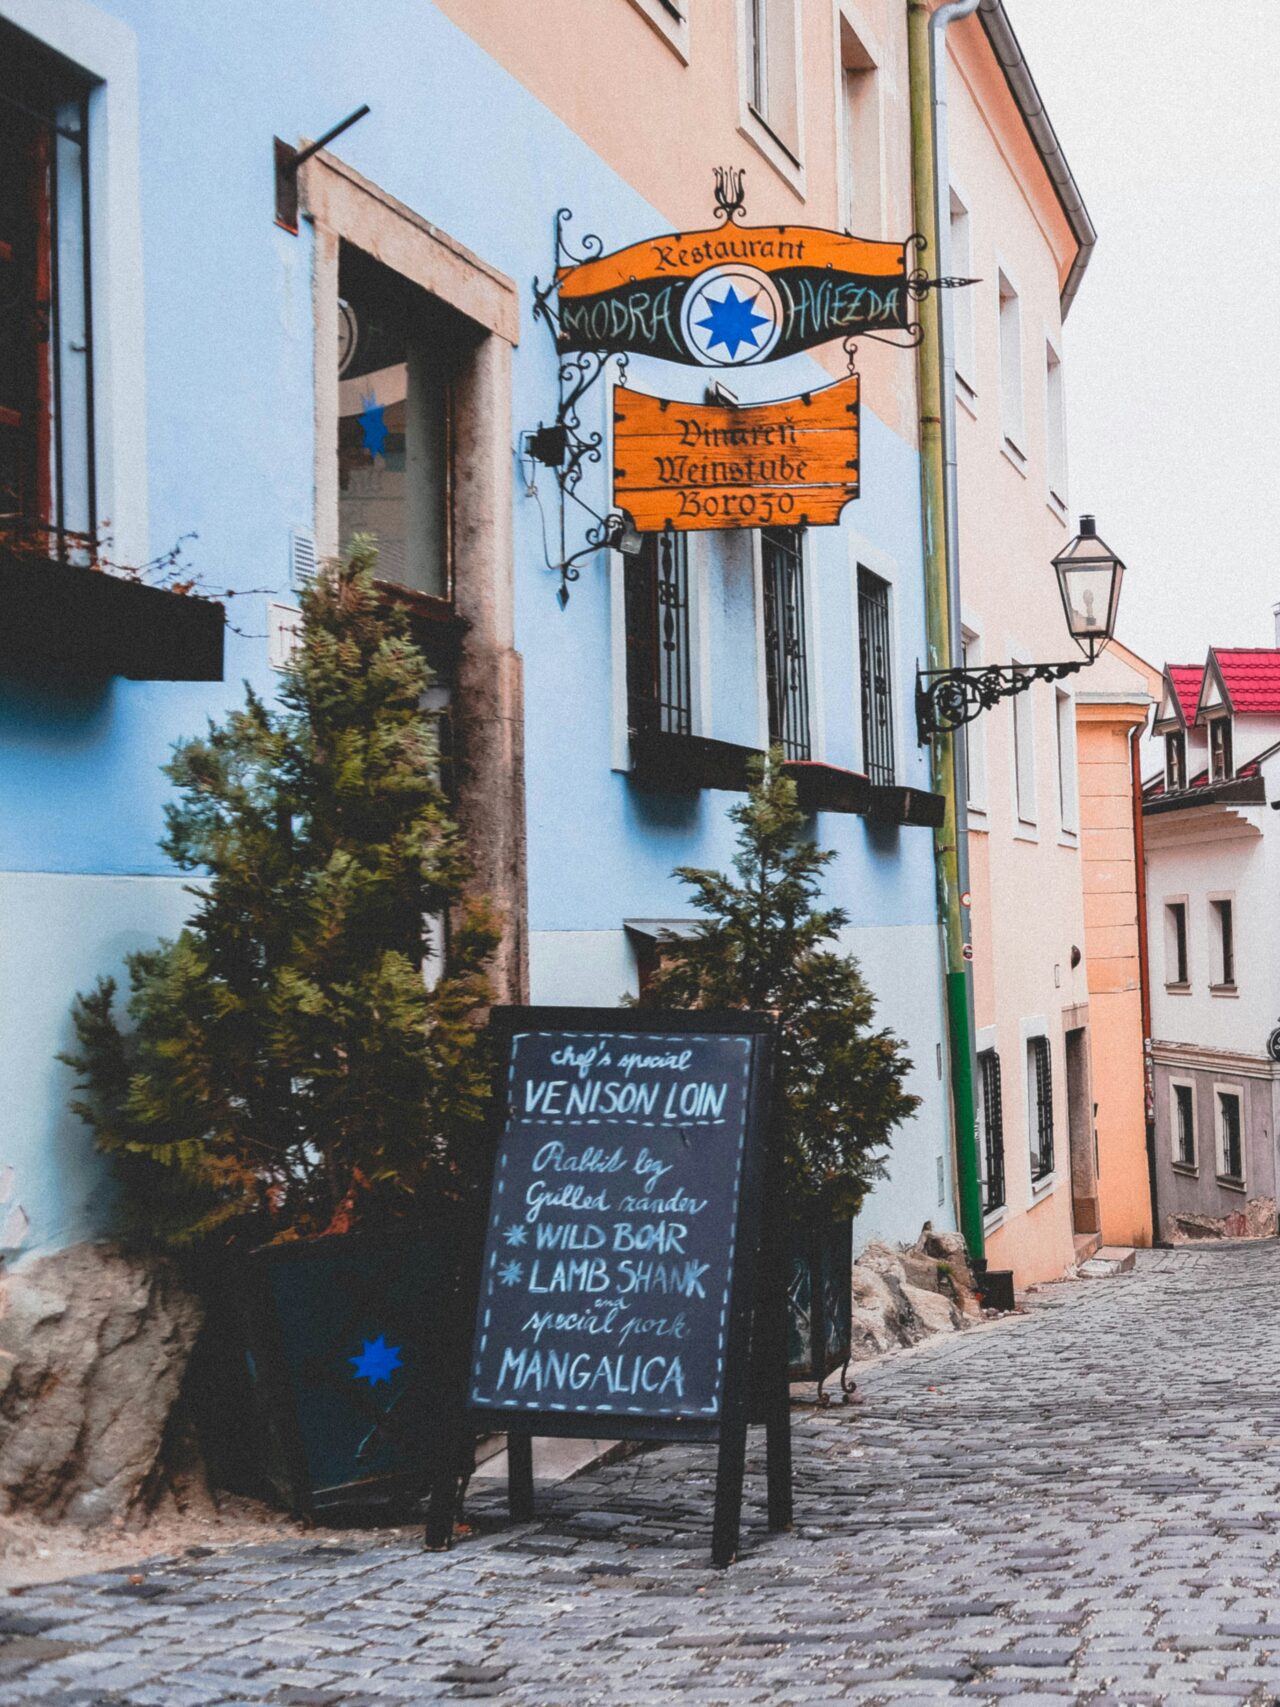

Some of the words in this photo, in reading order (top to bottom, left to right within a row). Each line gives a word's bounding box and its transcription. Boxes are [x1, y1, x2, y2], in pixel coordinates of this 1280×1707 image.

[654, 239, 806, 270] Restaurant
[654, 455, 808, 483] Weinstube
[551, 1040, 610, 1079] chef's
[617, 1049, 693, 1078] special
[524, 1079, 660, 1116] VENISON
[663, 1081, 728, 1118] LOIN
[532, 1140, 628, 1173] Rabbit
[633, 1147, 674, 1194] leg
[525, 1180, 611, 1223] Grilled
[535, 1222, 606, 1251] WILD
[612, 1220, 688, 1255] BOAR
[527, 1257, 610, 1294] LAMB
[616, 1258, 710, 1299] SHANK
[594, 1297, 631, 1310] and
[520, 1307, 618, 1344] special
[496, 1347, 684, 1398] MANGALICA
